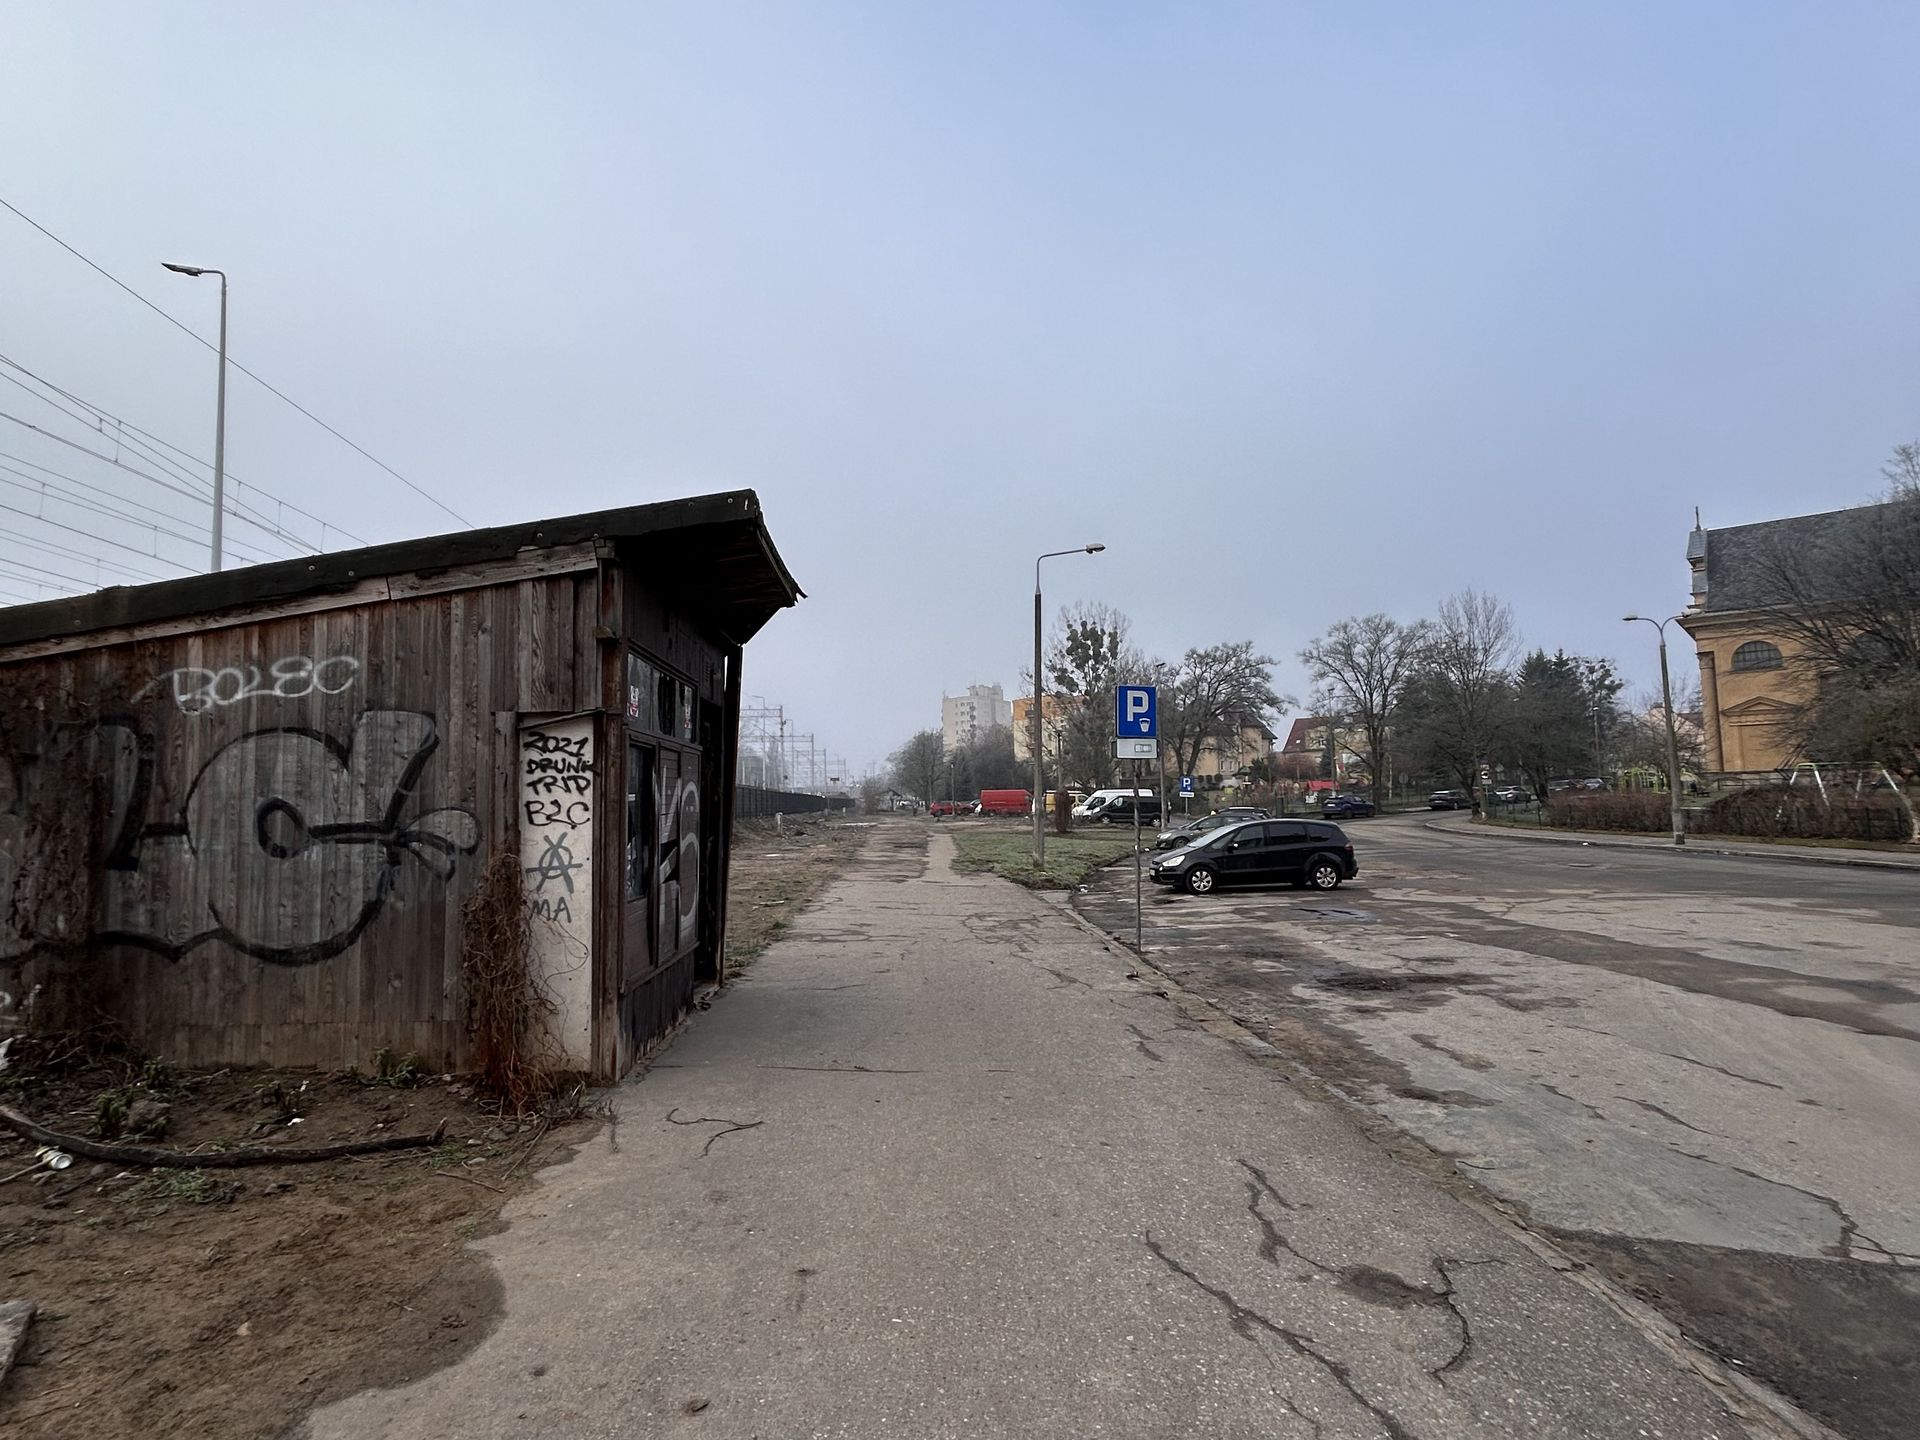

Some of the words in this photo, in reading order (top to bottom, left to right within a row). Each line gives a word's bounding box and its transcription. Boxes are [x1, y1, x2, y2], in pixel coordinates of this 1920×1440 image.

[1127, 690, 1149, 722] P
[523, 731, 589, 757] 2021
[1183, 778, 1191, 787] P
